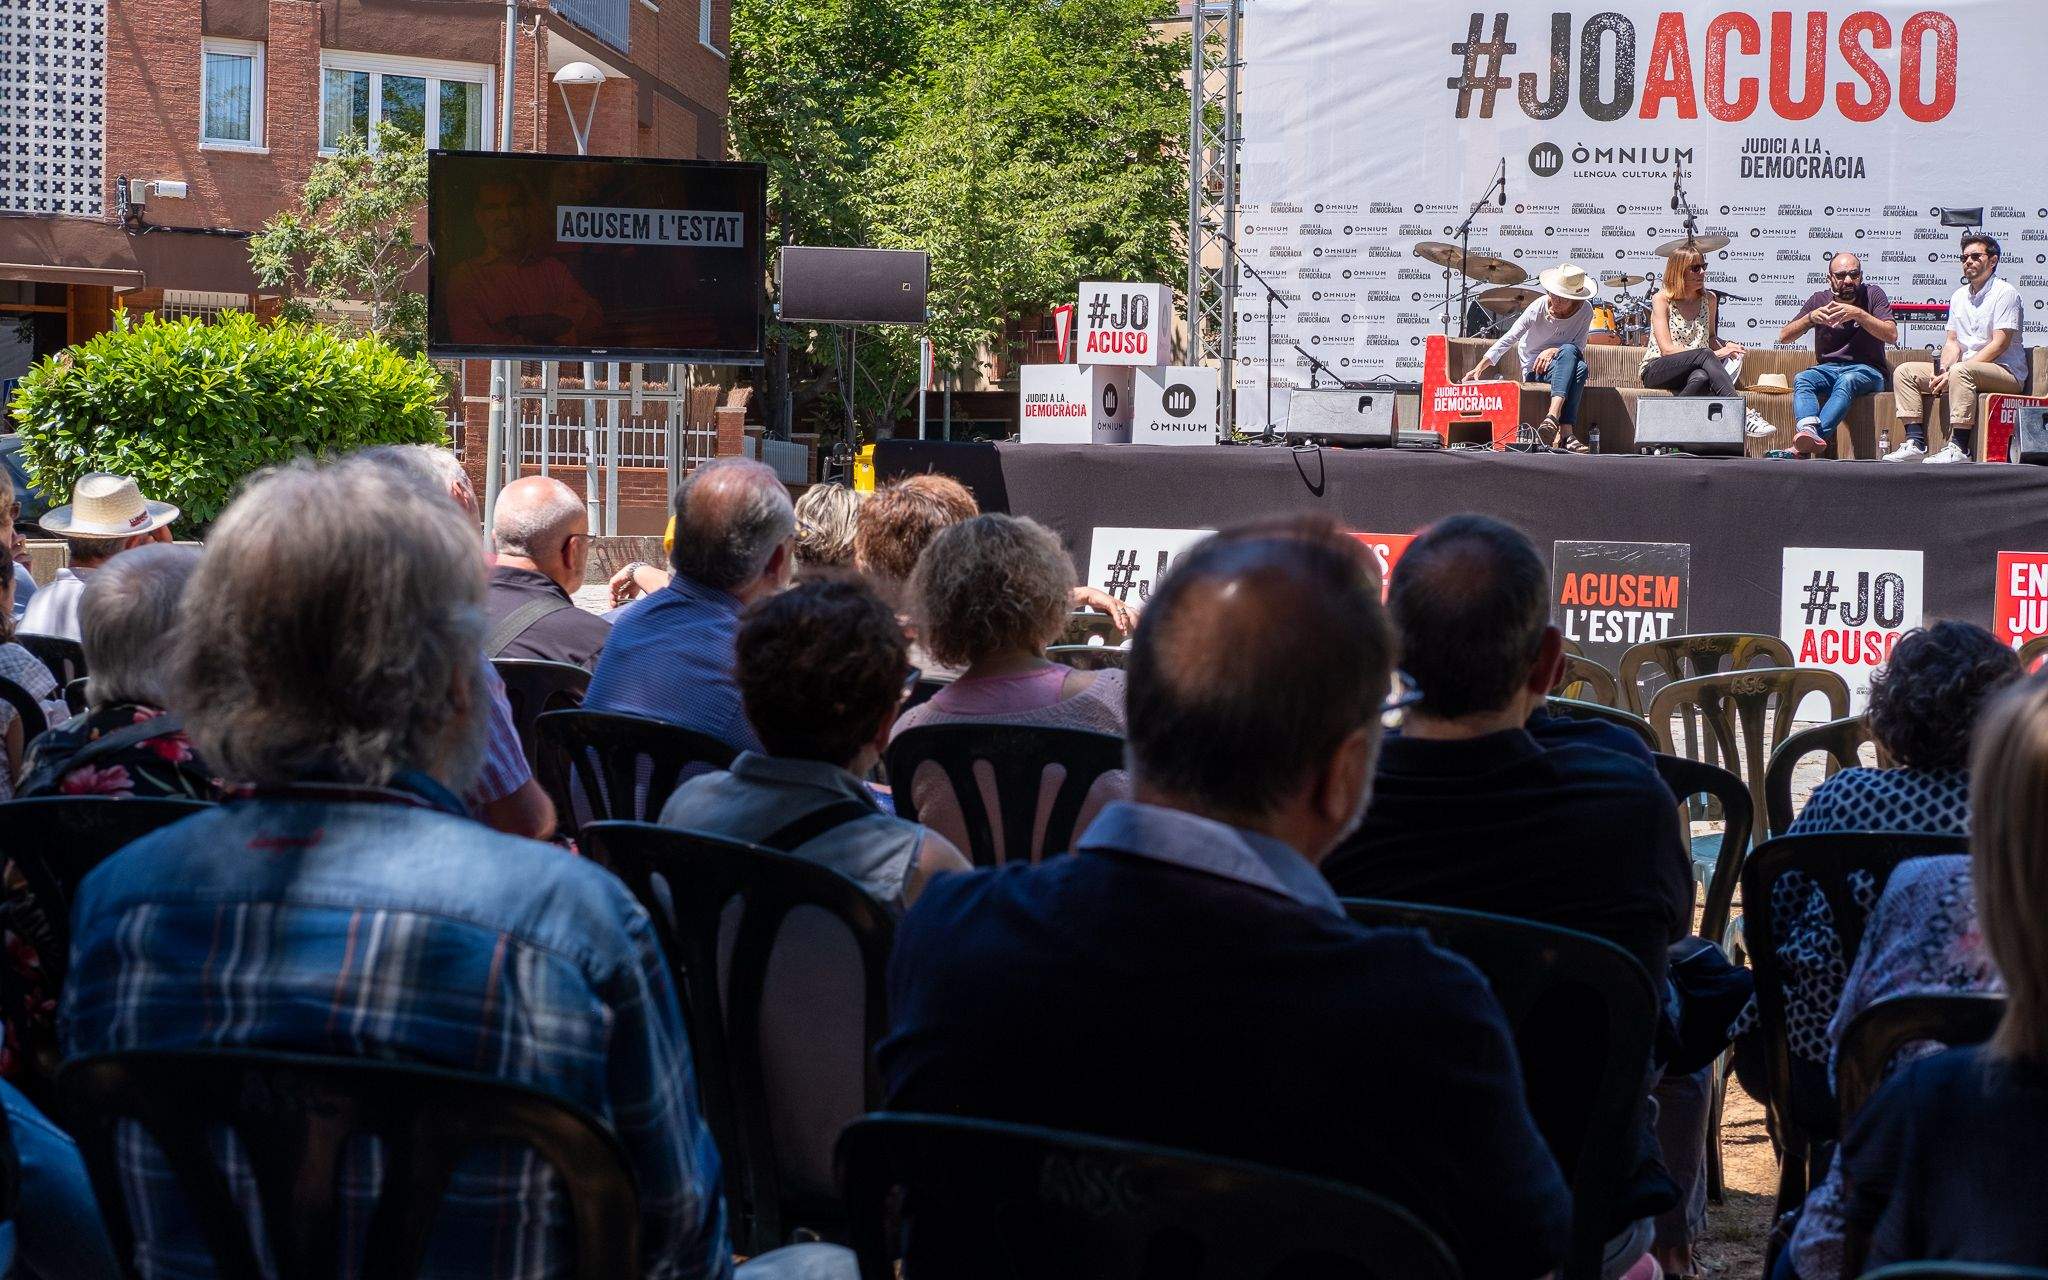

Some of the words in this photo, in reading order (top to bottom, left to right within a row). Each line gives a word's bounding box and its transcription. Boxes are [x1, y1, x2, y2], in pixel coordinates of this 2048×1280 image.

[1447, 11, 1958, 123] #JOACUSO
[1571, 142, 1693, 164] ÒMNIUM
[1741, 137, 1787, 155] JUDICI
[1791, 137, 1800, 154] A
[1805, 137, 1820, 154] LA
[1573, 171, 1618, 179] LLENGUA
[1622, 171, 1668, 179] CULTURA
[1740, 150, 1866, 179] DEMOCRÀCIA
[561, 211, 650, 240] ACUSEM
[659, 214, 740, 242] L'ESTAT
[1087, 293, 1149, 330] #JO
[1086, 331, 1148, 354] ACUSO
[1025, 394, 1047, 403] JUDICI
[1050, 394, 1054, 402] A
[1056, 394, 1065, 402] LA
[1434, 386, 1460, 397] JUDICI
[1462, 387, 1467, 397] A
[1469, 386, 1478, 397] LA
[1434, 393, 1503, 412] DEMOCRÀCIA
[1025, 401, 1087, 417] DEMOCRÀCIA
[1150, 420, 1208, 432] ÒMNIUM
[1560, 572, 1679, 609] ACUSEM
[1800, 570, 1905, 629] #JO
